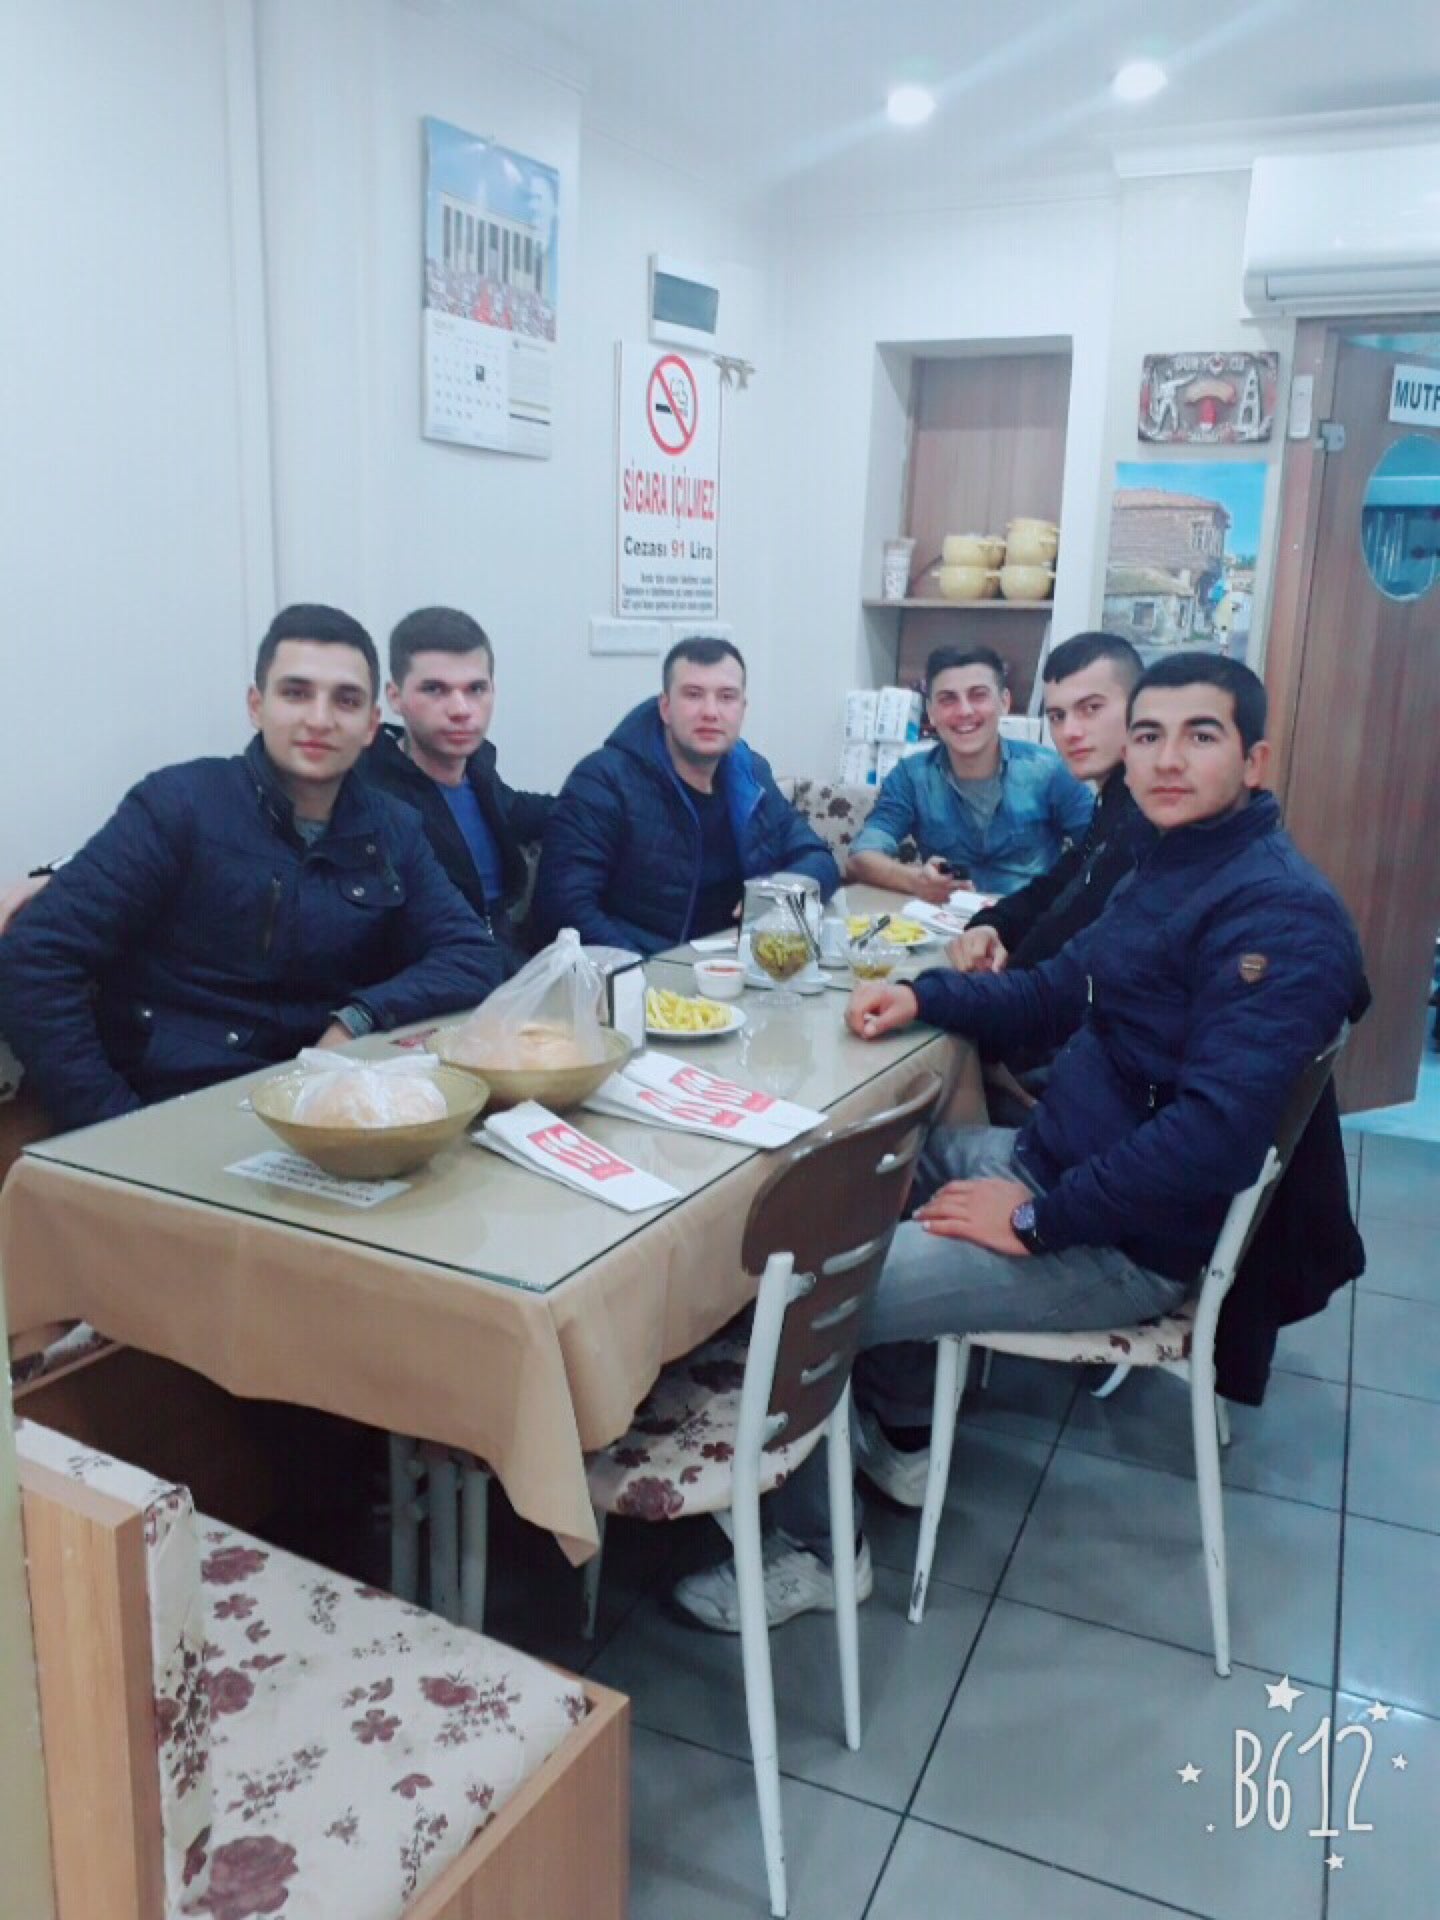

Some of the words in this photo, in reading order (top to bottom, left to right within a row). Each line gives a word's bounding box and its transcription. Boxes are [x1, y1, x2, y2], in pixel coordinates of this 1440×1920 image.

[623, 459, 668, 515] SİGARA
[671, 464, 715, 528] İÇİLMEZ
[624, 536, 667, 557] Cezası
[671, 539, 685, 559] 91
[689, 541, 713, 561] Lira
